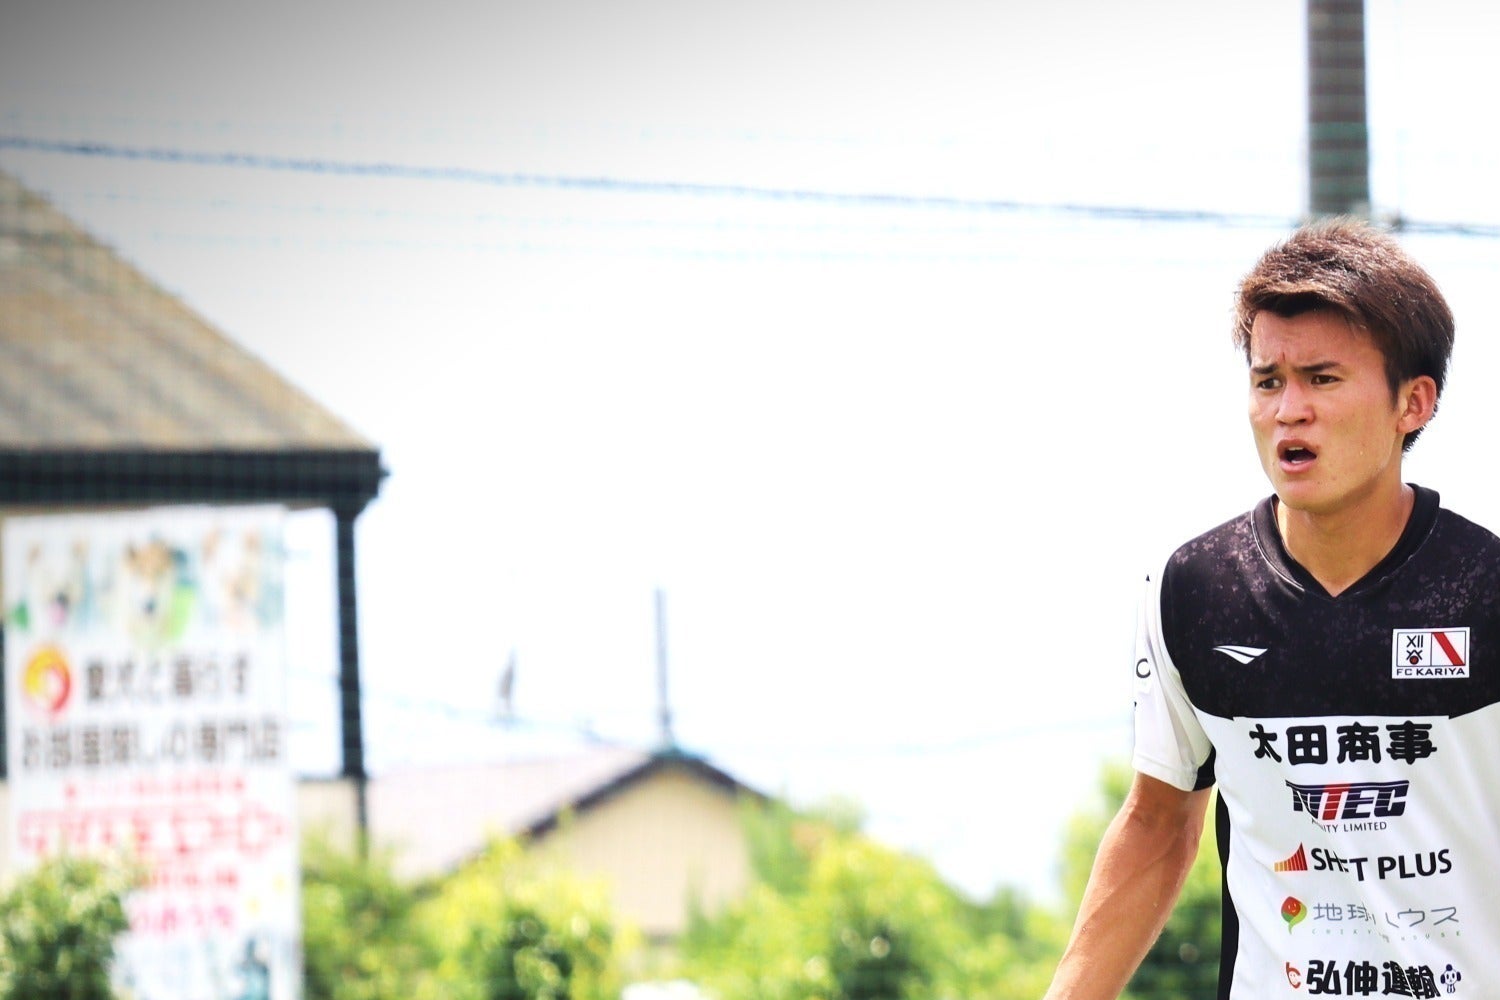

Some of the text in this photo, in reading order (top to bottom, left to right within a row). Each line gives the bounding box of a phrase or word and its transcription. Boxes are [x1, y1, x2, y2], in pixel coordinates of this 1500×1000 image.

[1397, 667, 1466, 676] FC KARIYA
[1249, 720, 1437, 765] 太田商事
[1343, 821, 1388, 833] LIMITED
[1377, 848, 1453, 880] PLUS
[1306, 959, 1441, 1000] 弘伸運輸
